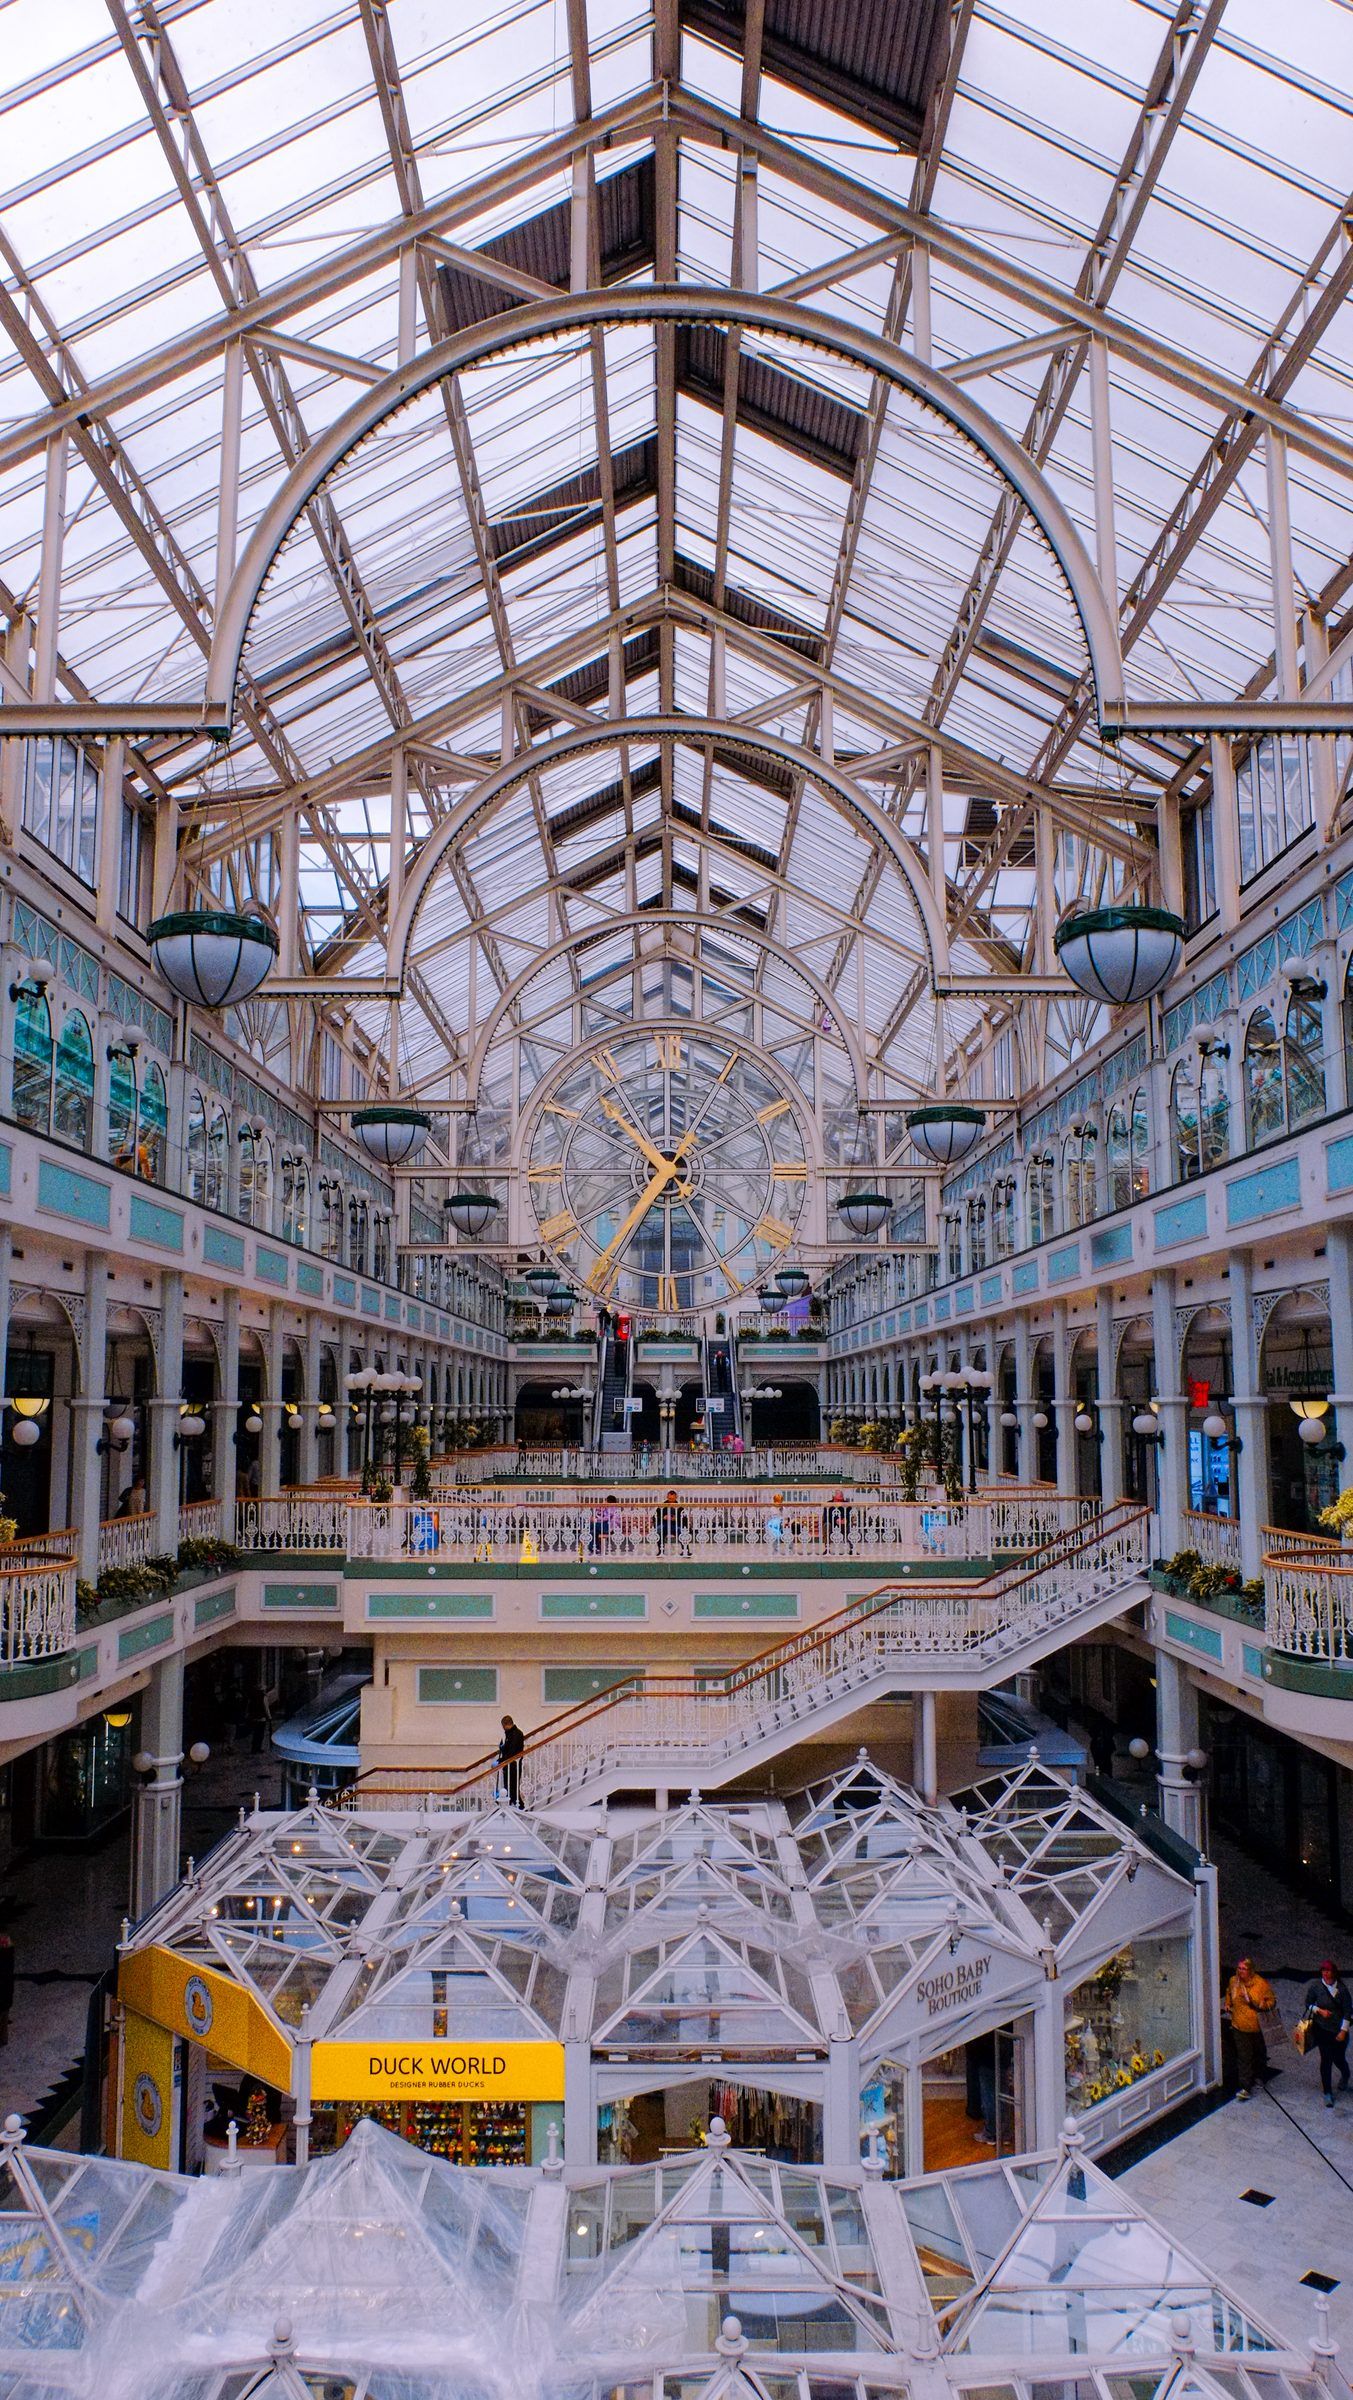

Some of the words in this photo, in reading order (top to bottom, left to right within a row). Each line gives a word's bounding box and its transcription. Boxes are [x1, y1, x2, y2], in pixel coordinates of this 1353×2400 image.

[774, 1162, 807, 1181] III
[917, 1972, 954, 2003] SOHO
[957, 1955, 992, 1987] BABY
[928, 1980, 982, 2016] BOUTIQUE
[369, 2057, 424, 2075] DUCK
[430, 2057, 506, 2075] WORLD
